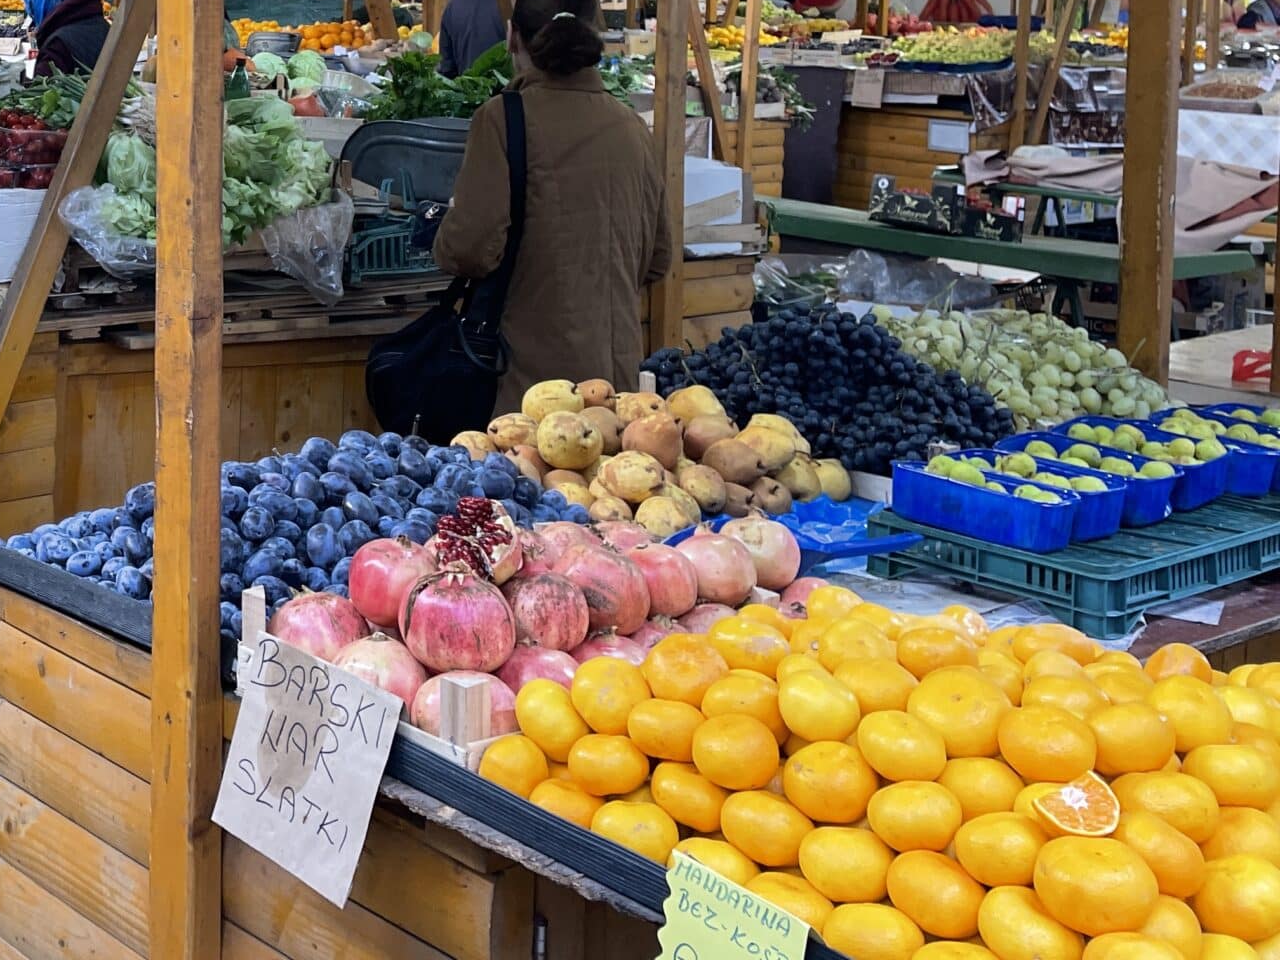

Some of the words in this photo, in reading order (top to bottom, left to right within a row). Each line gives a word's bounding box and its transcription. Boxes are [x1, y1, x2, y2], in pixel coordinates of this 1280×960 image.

[250, 638, 387, 749] BARSKI
[232, 758, 349, 854] SLATKI
[673, 860, 792, 938] MANDARINA
